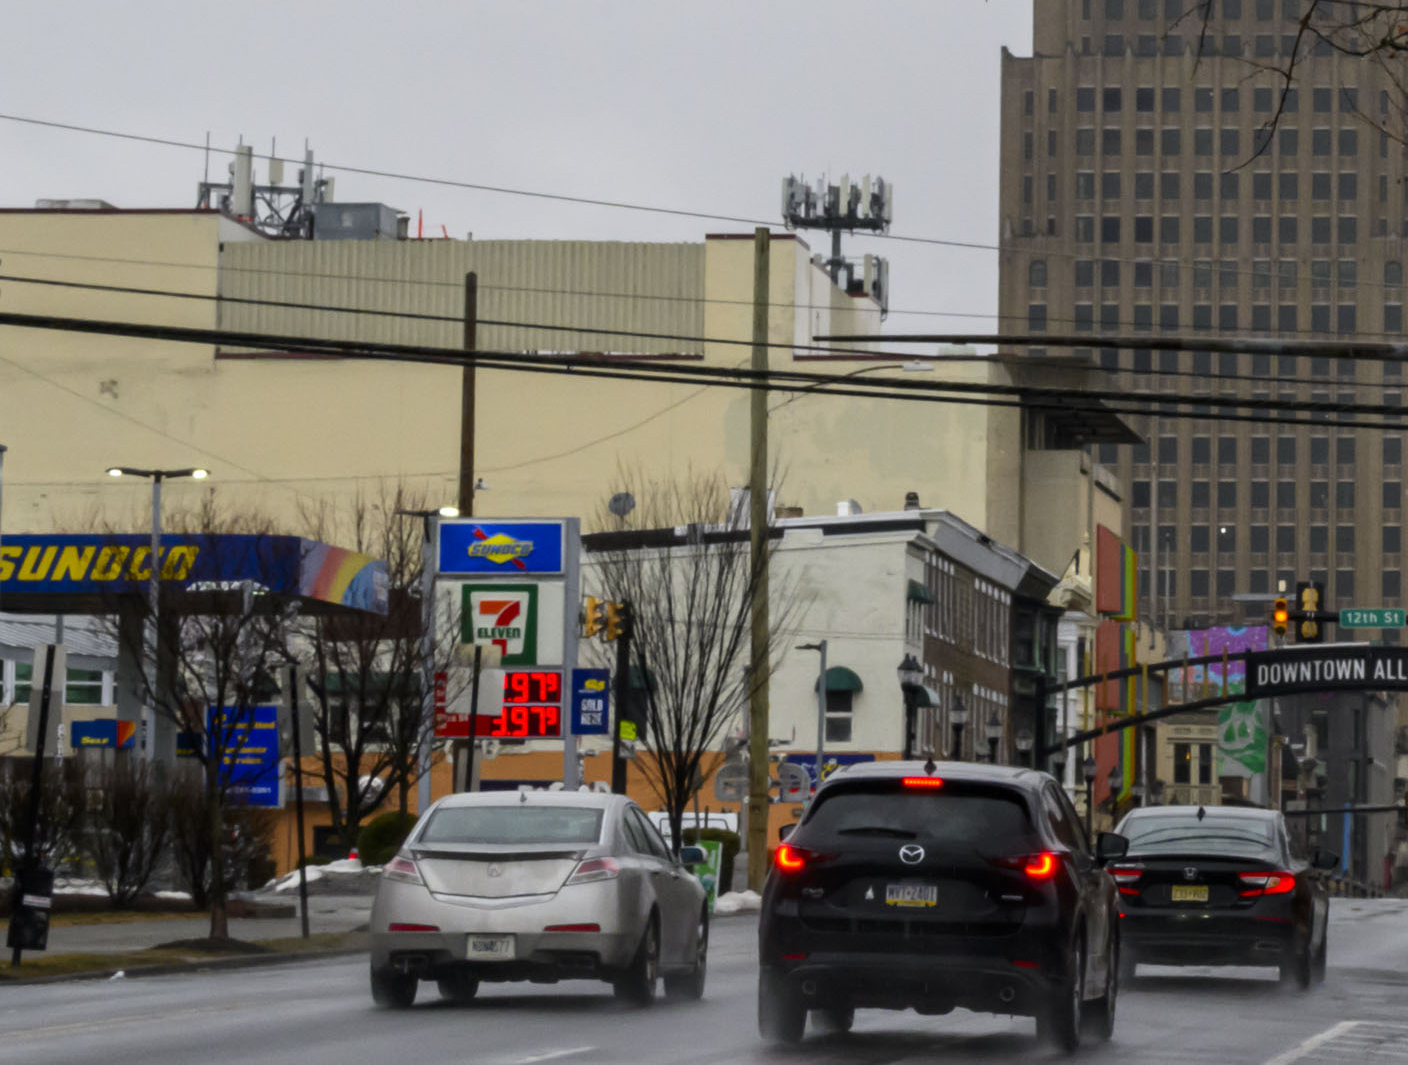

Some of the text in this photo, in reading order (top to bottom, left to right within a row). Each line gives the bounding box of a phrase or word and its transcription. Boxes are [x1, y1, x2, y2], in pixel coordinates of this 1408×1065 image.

[471, 543, 531, 555] SUNOCO
[0, 545, 200, 581] SUNOCO
[479, 600, 521, 657] 7
[1346, 612, 1400, 624] 12th St
[1257, 658, 1366, 685] DOWNTOWN
